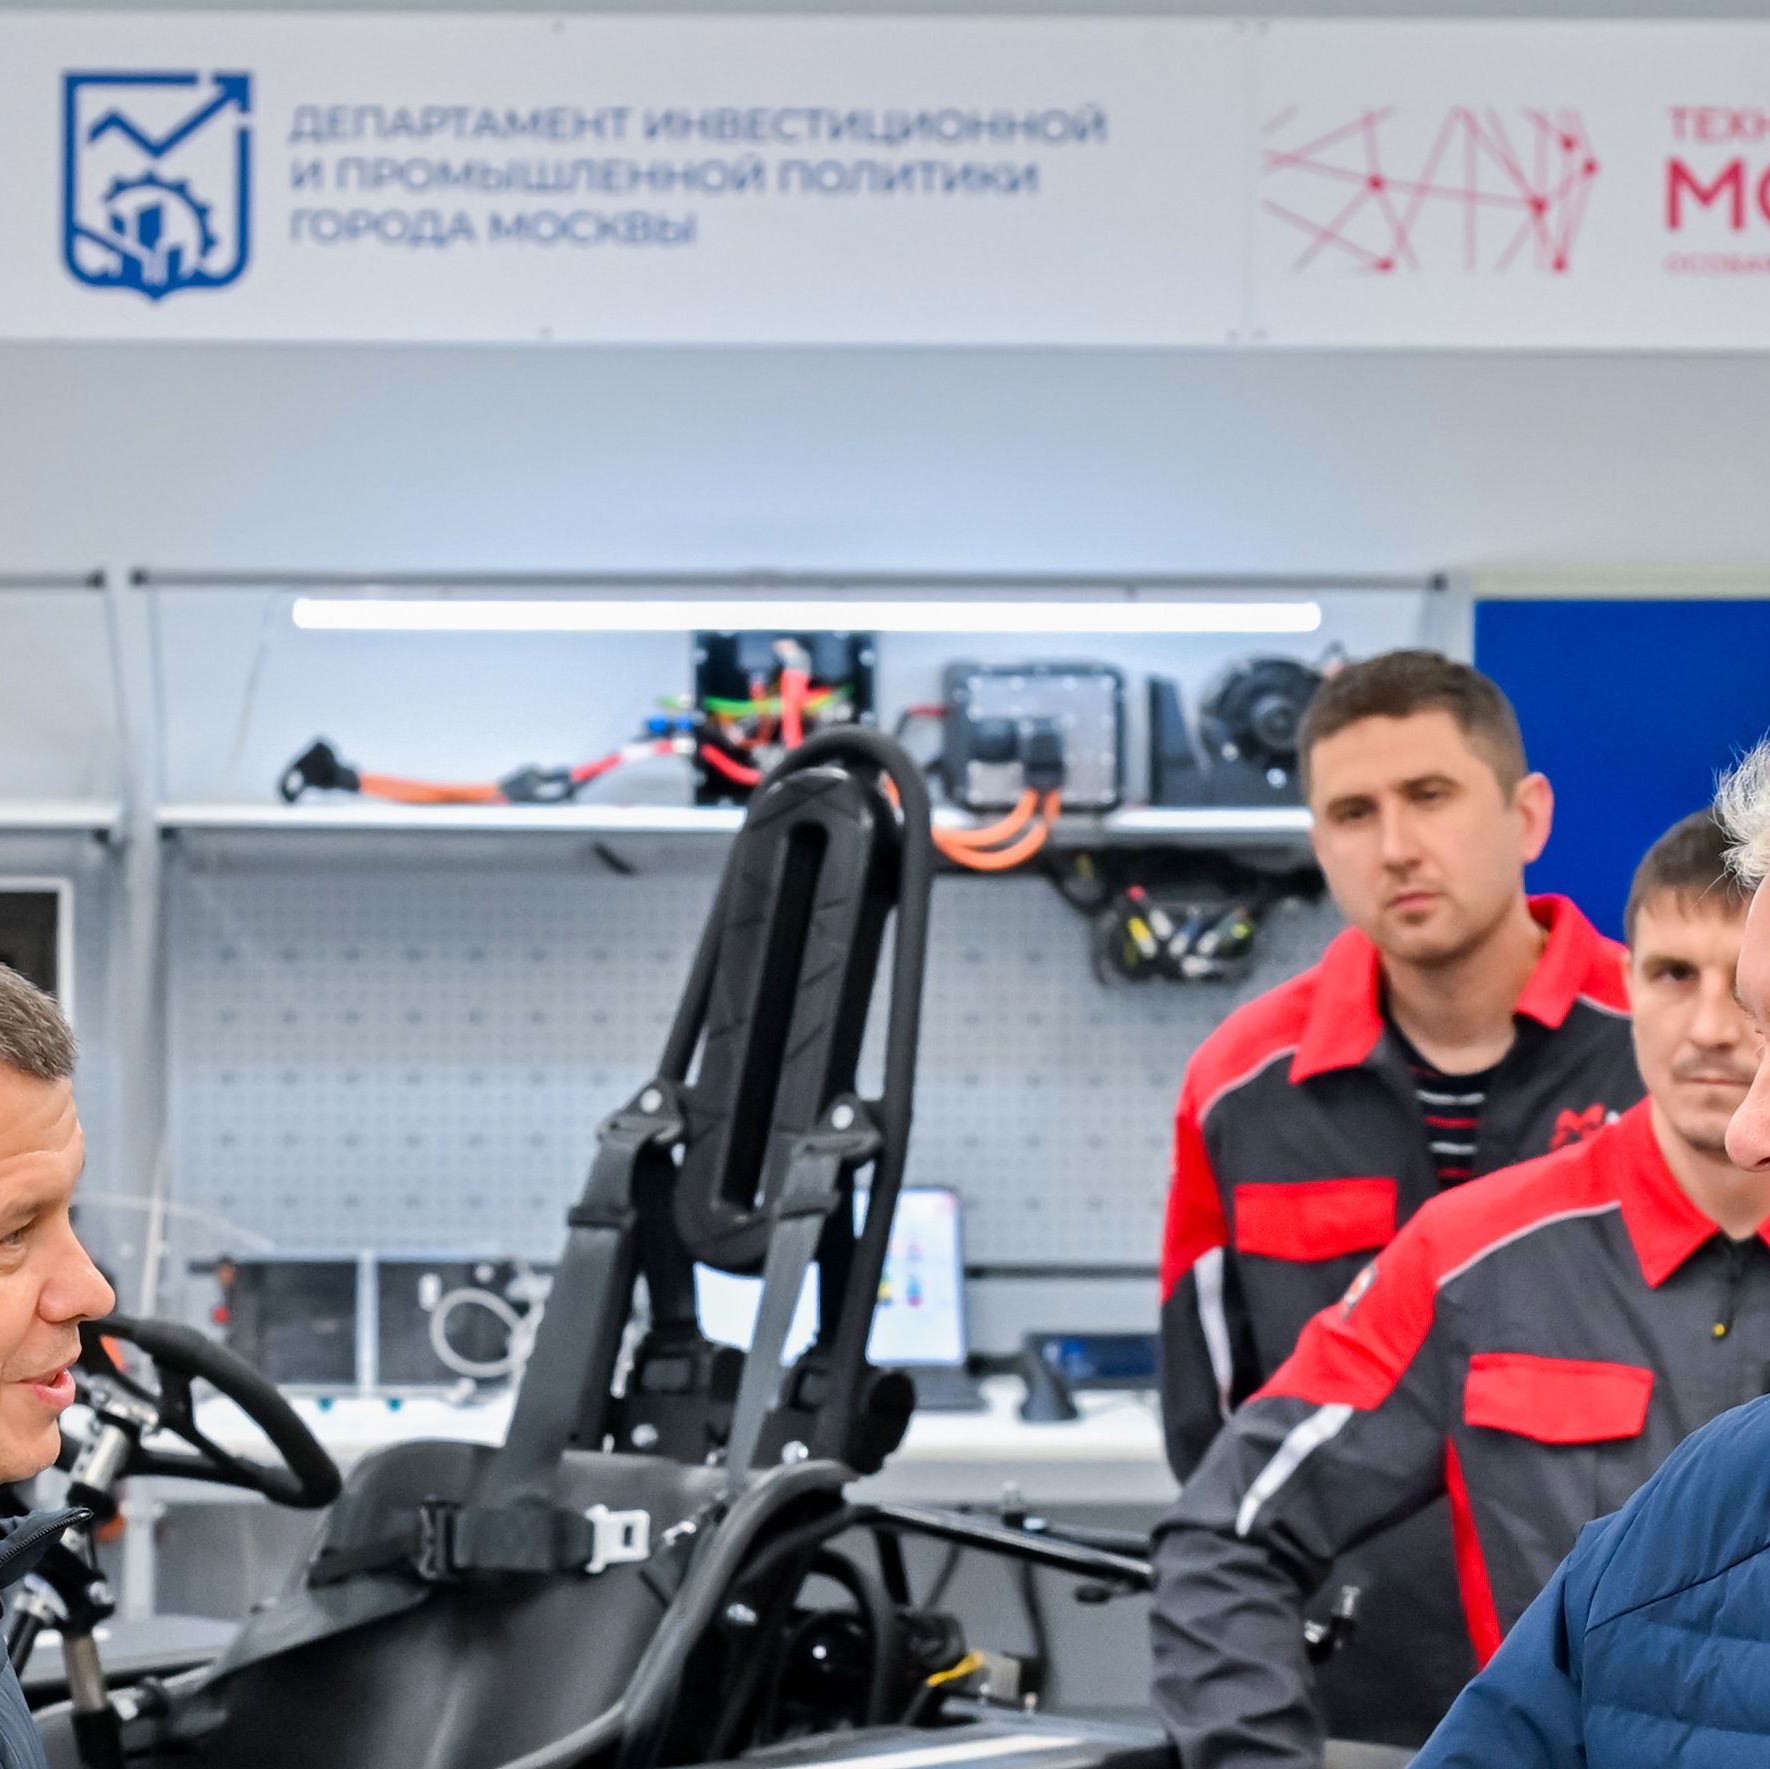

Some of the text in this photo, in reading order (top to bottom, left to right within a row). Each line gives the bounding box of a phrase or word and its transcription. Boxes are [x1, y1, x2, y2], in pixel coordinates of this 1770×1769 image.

[287, 101, 1108, 146] ДЕПАРТАМЕНТ ИНВЕСТИЦИОННОЙ
[291, 153, 1040, 195] И ПРОМЫШЛЕННОЙ ПОЛИТИКИ
[290, 208, 697, 248] ГОРОДА МОСКВЫ
